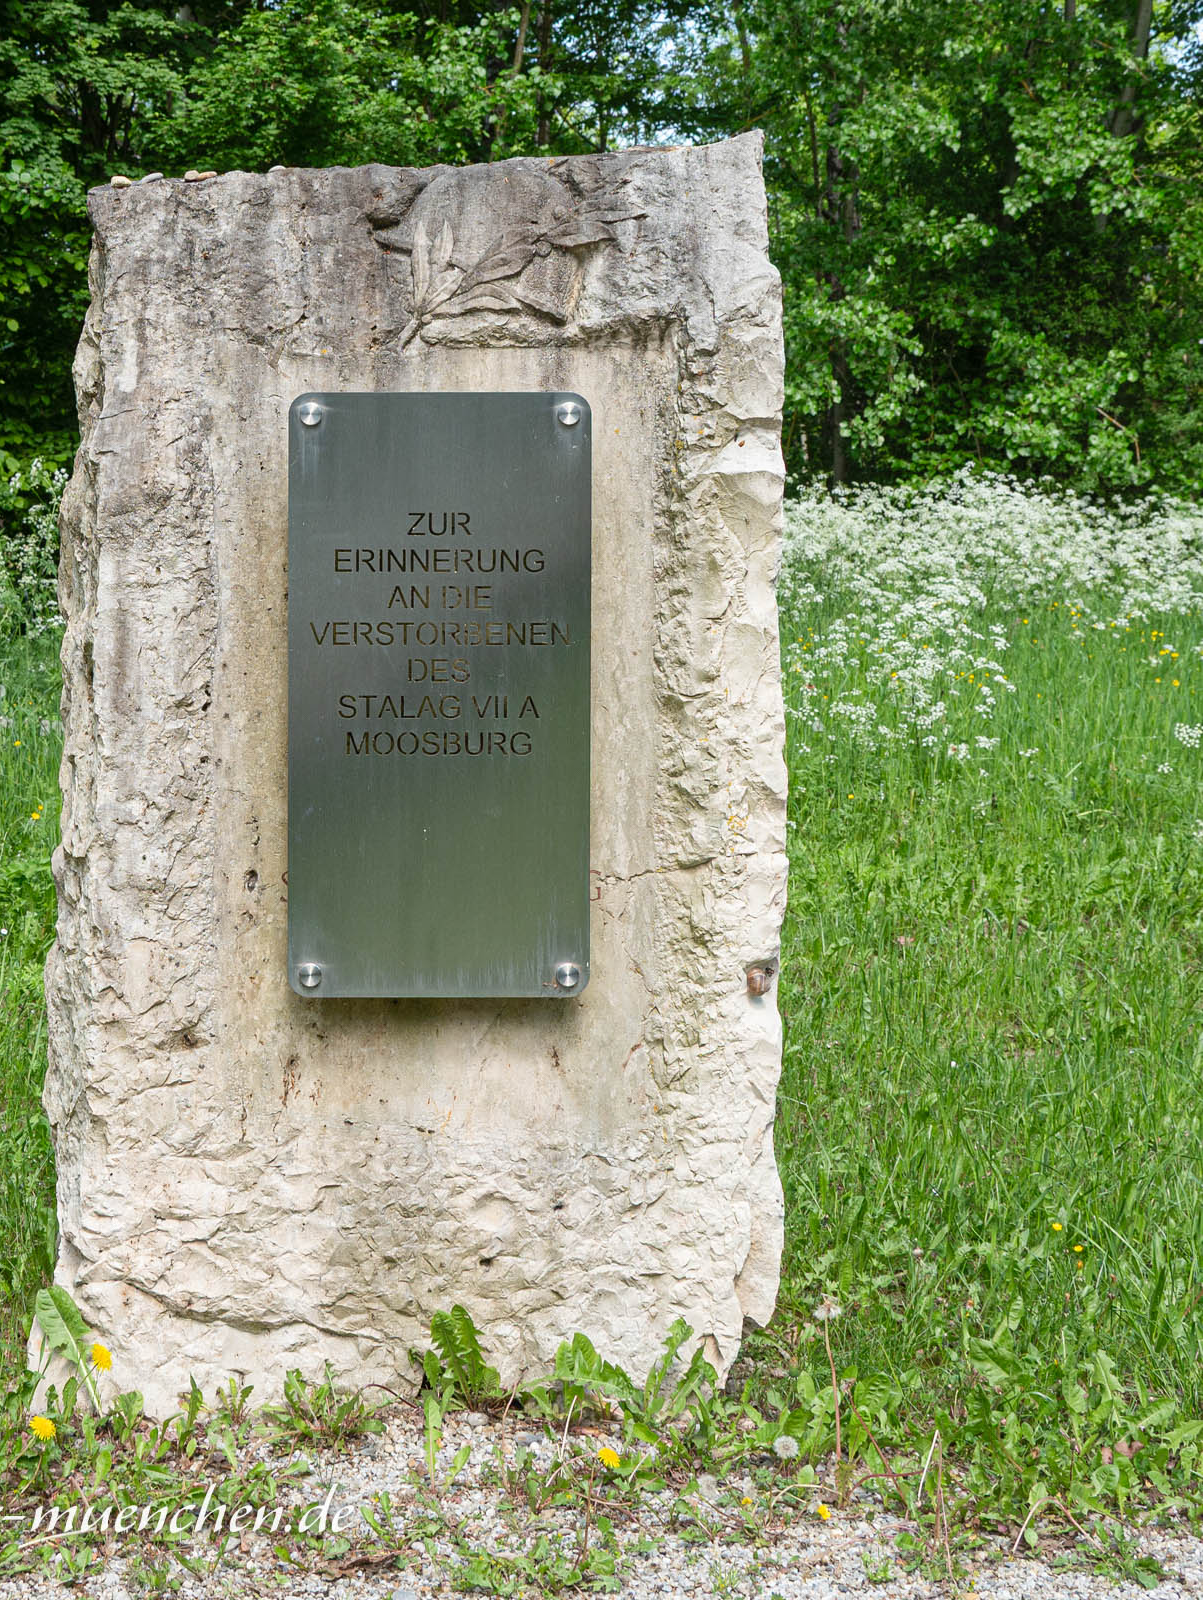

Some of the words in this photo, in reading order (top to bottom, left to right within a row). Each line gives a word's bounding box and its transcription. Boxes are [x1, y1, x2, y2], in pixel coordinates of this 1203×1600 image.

[407, 512, 473, 537] ZUR
[334, 549, 545, 573] ERINNERUNG
[387, 585, 430, 609] AN
[441, 585, 493, 609] DIE
[309, 622, 570, 646] VERSTORBENEN
[407, 658, 471, 683] DES
[337, 695, 462, 720] STALAG
[472, 695, 508, 719] VII
[518, 695, 541, 719] A
[346, 731, 533, 756] MOOSBURG
